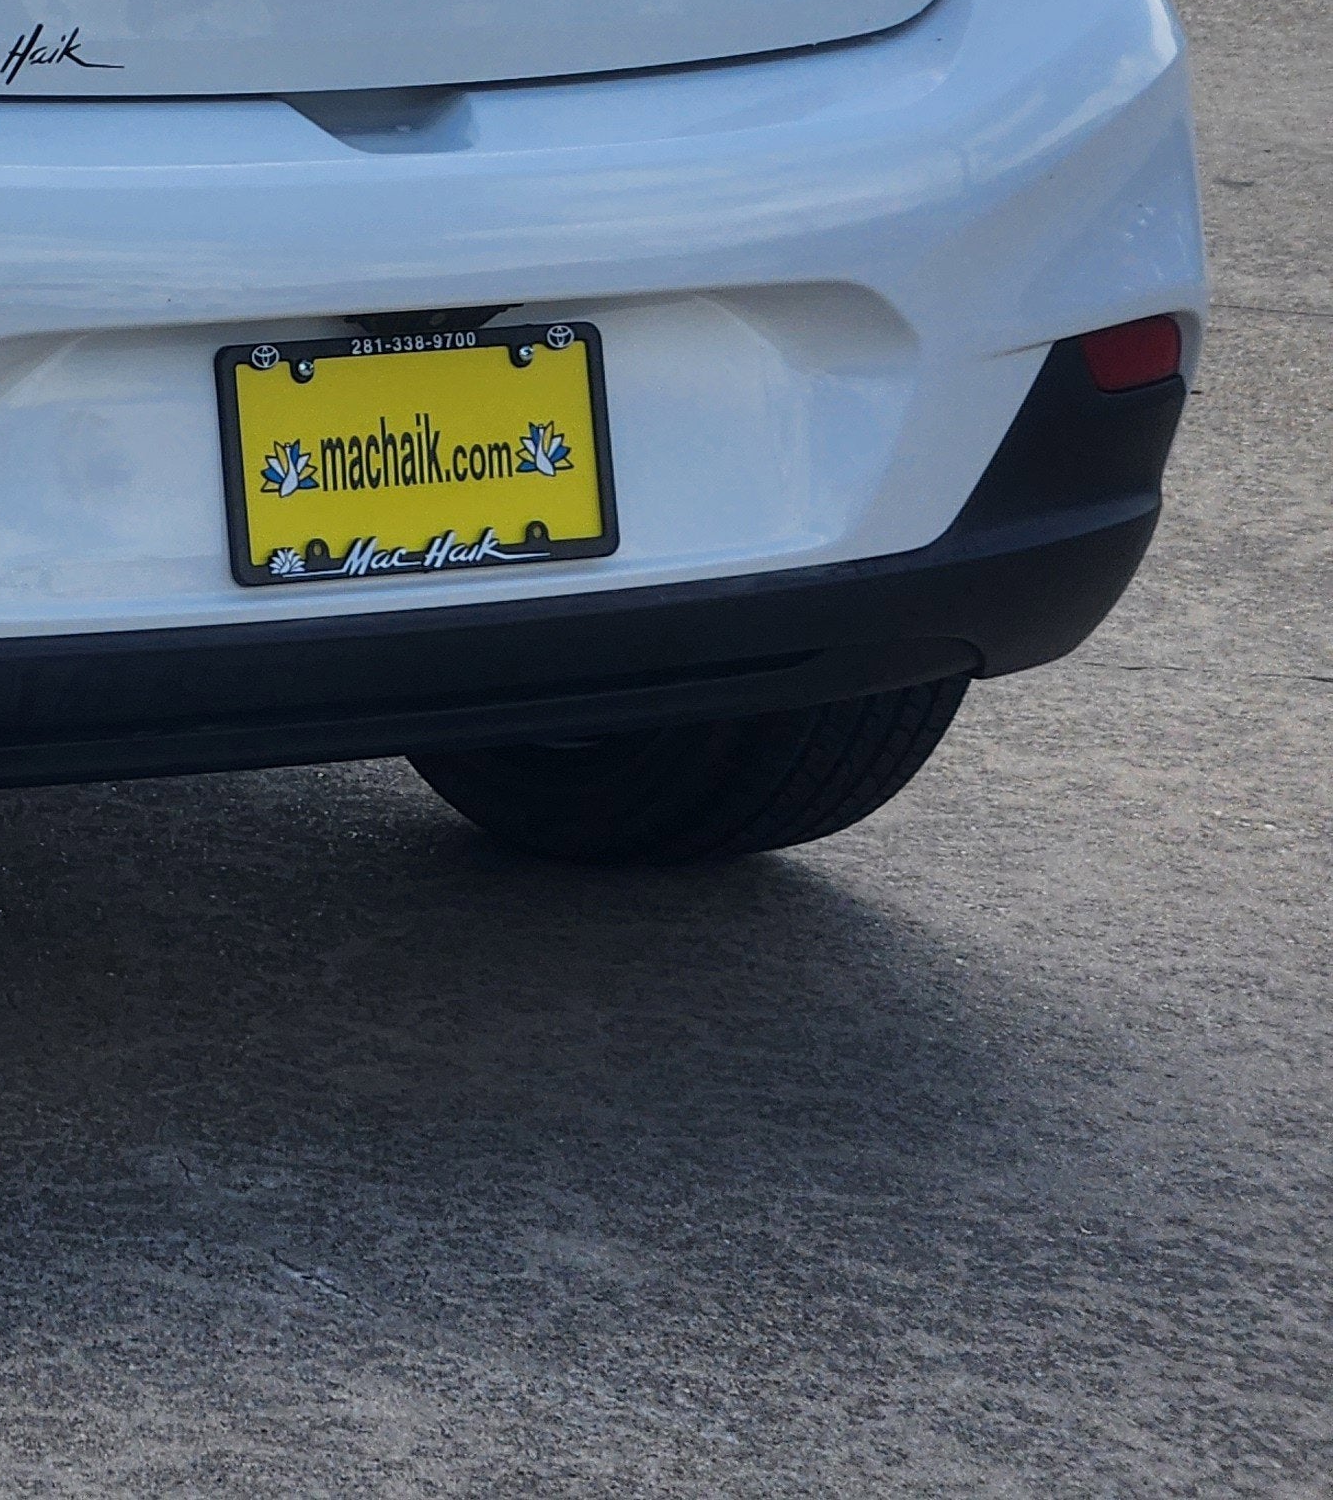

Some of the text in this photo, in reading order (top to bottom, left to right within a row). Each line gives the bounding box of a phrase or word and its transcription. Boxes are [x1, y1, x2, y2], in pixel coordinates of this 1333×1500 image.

[0, 23, 124, 85] Haik
[351, 331, 477, 355] 281-338-9700
[321, 413, 514, 492] machaik.com
[341, 527, 550, 577] Mac Haik
